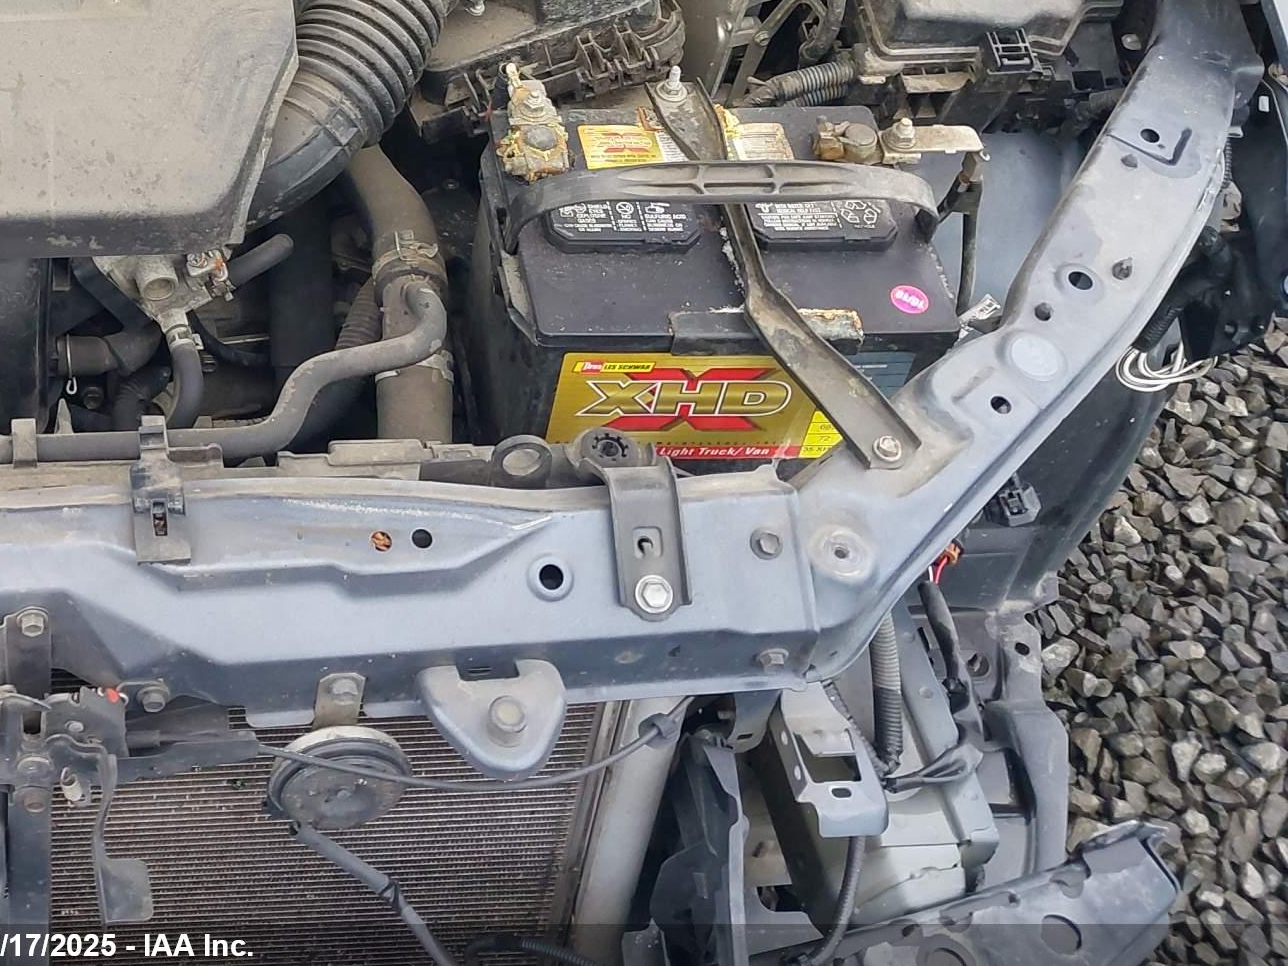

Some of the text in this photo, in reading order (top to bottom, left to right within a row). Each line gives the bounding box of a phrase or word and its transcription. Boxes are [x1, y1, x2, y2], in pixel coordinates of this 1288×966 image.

[575, 380, 793, 418] XHD
[659, 447, 695, 458] Light
[744, 447, 770, 456] Van
